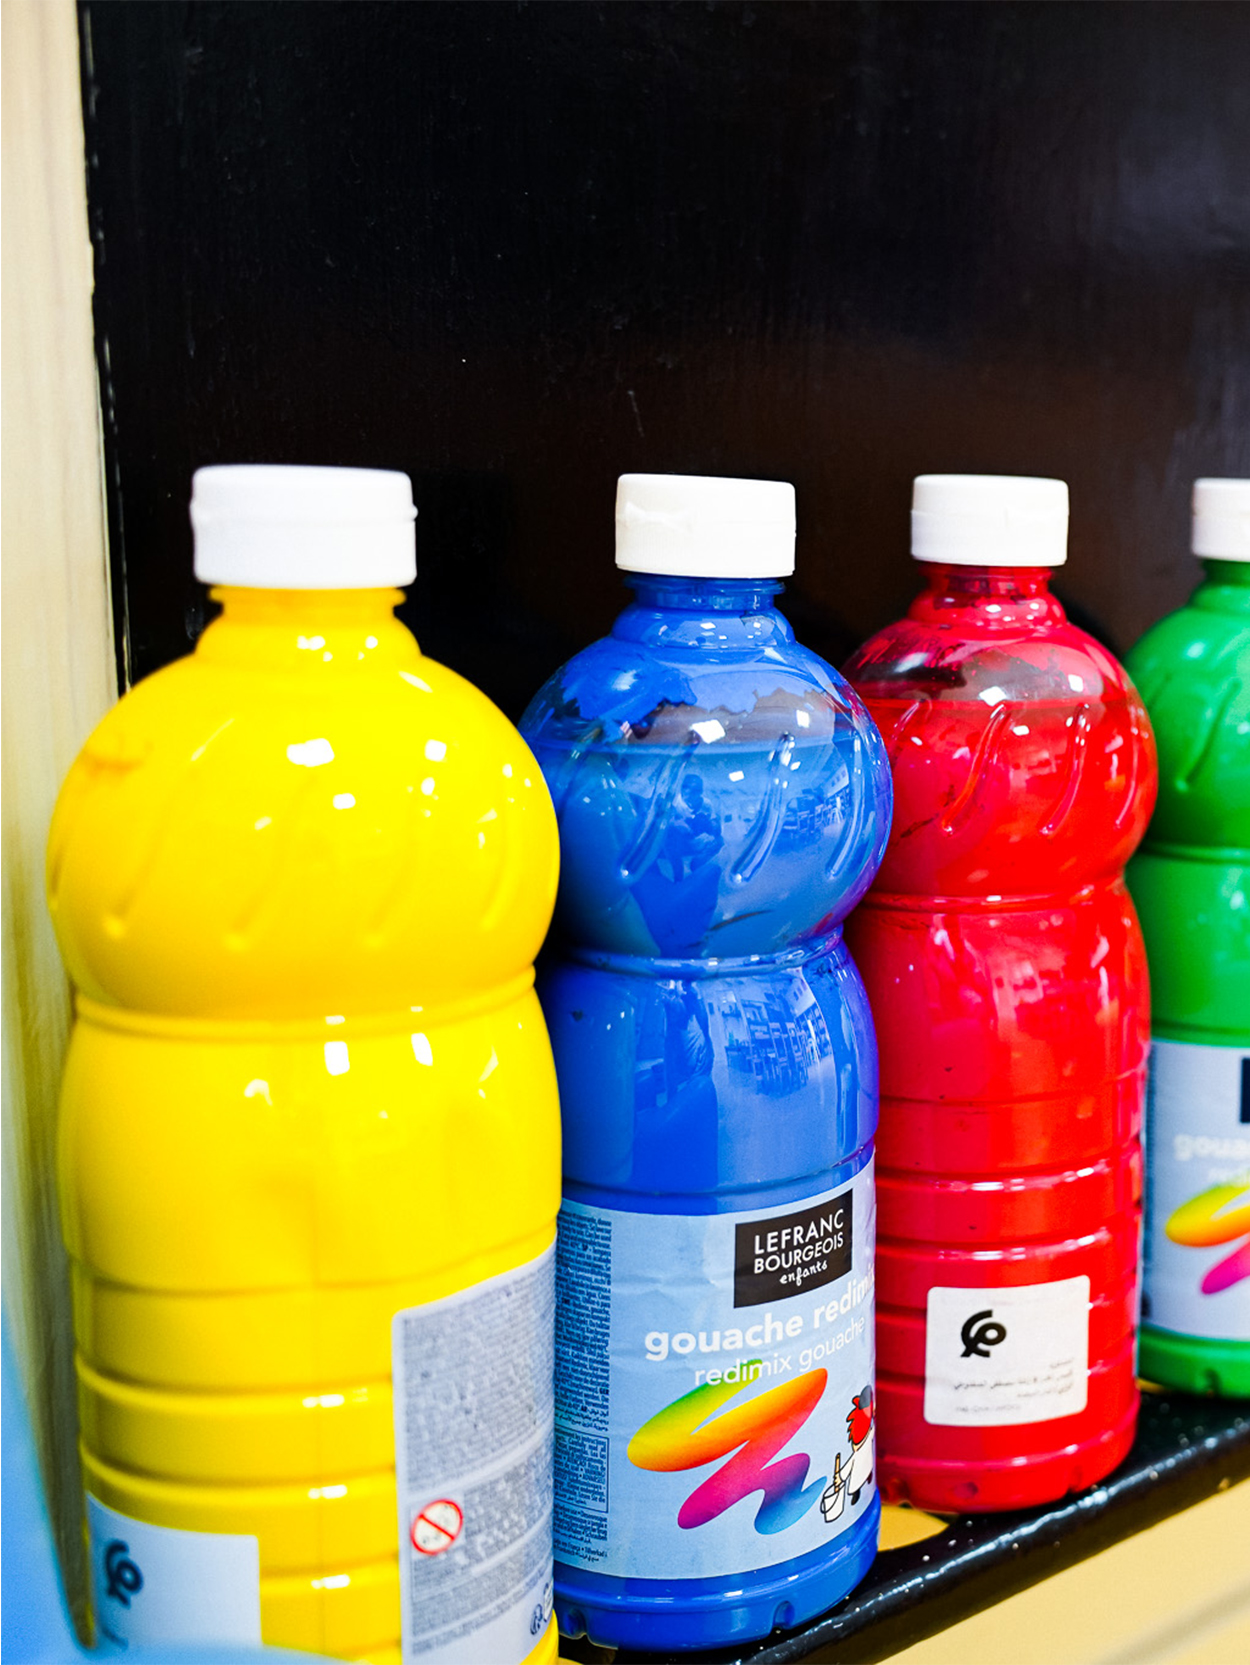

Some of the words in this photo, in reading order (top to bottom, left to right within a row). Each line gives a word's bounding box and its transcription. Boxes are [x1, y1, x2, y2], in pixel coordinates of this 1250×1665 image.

[754, 1208, 844, 1255] LEFRANC
[754, 1231, 844, 1274] BOURGEOIS
[779, 1260, 828, 1286] enfants
[644, 1312, 804, 1362] gouache
[695, 1353, 792, 1386] redimix
[799, 1317, 865, 1373] gouache
